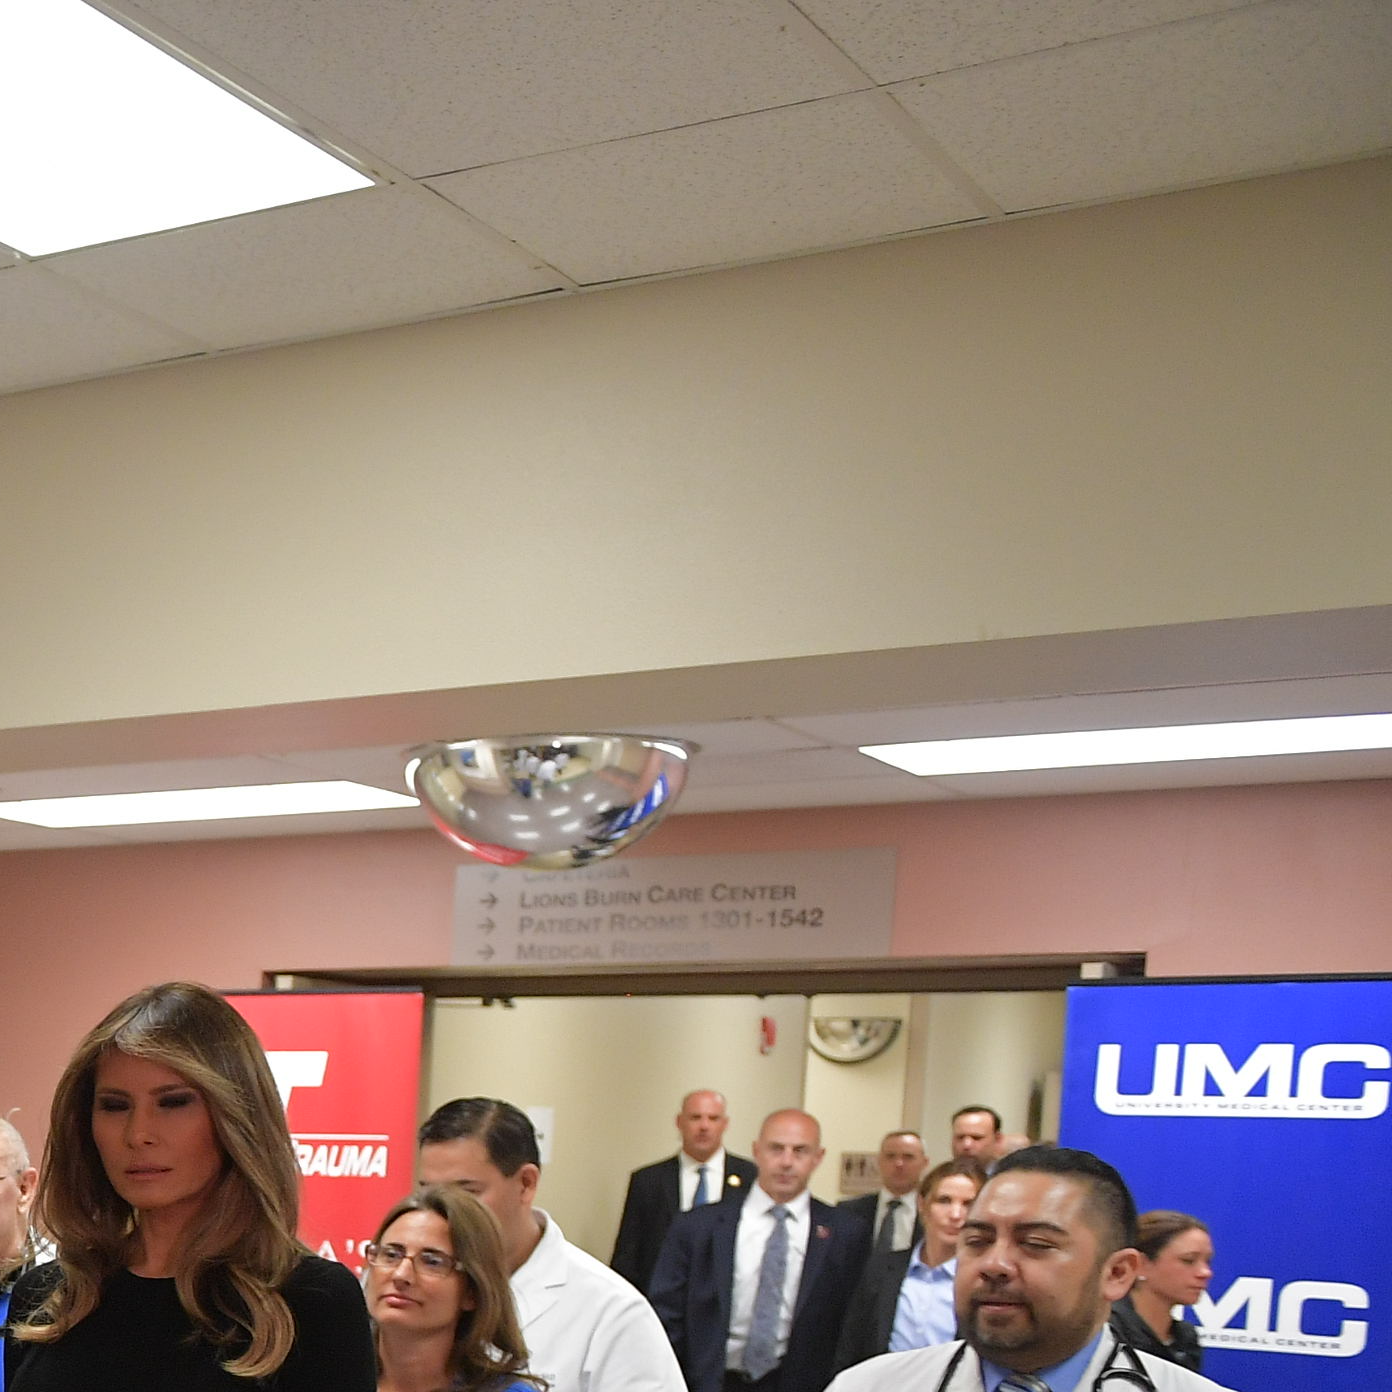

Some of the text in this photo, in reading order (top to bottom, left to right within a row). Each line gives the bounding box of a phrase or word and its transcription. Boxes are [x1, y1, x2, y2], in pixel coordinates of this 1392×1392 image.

[520, 884, 797, 910] LIONS BURN CARE CENTER
[519, 908, 824, 934] PATIENT ROOMS 1301-1542
[517, 943, 604, 961] MEDICAL
[1094, 1042, 1391, 1119] UMC
[1217, 1103, 1290, 1111] MEDICAL
[1297, 1104, 1365, 1112] CENTER
[1170, 1276, 1370, 1358] MC
[1276, 1338, 1341, 1350] CENTER
